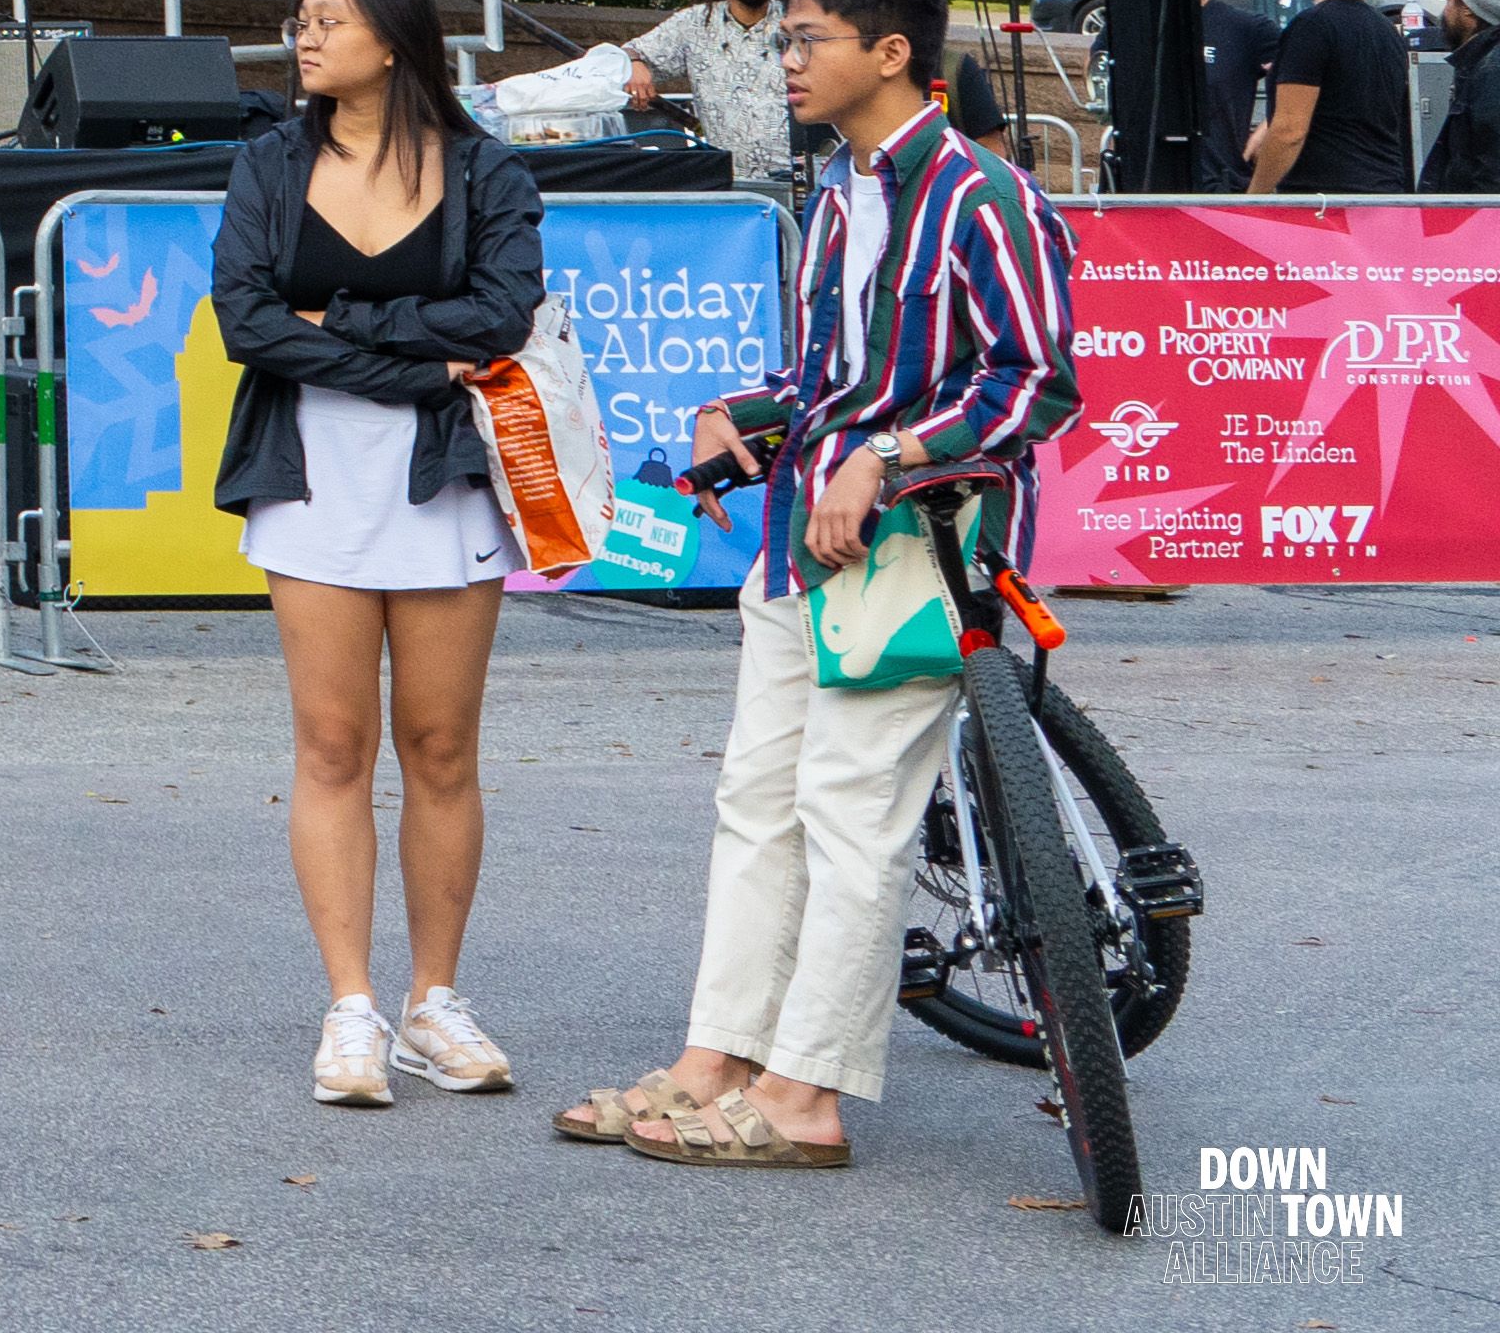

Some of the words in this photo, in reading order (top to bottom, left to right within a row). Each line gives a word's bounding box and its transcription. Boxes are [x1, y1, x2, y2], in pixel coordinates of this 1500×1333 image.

[1080, 260, 1163, 281] Austin
[1168, 260, 1269, 282] Alliance
[1275, 260, 1359, 282] thanks
[1365, 266, 1404, 282] our
[1185, 301, 1288, 331] LINCOLN
[1071, 330, 1146, 358] etro
[1158, 326, 1273, 356] PROPERTY
[1344, 320, 1466, 364] DPR
[582, 322, 765, 387] -Along
[1188, 358, 1305, 386] COMPANY
[1347, 374, 1471, 386] CONSTRUCTION
[610, 392, 699, 444] Str
[1220, 414, 1250, 437] JE
[1256, 414, 1325, 437] Dunn
[1220, 441, 1265, 464] The
[1269, 441, 1357, 464] Linden
[1104, 465, 1171, 482] BIRD
[615, 508, 646, 529] KUT
[1077, 507, 1131, 532] Tree
[1139, 507, 1243, 536] Lighting
[1261, 506, 1338, 543] FOX
[1342, 506, 1375, 542] 7
[651, 525, 679, 547] NEWS
[1148, 536, 1244, 560] Partner
[1262, 545, 1378, 558] AUSTIN
